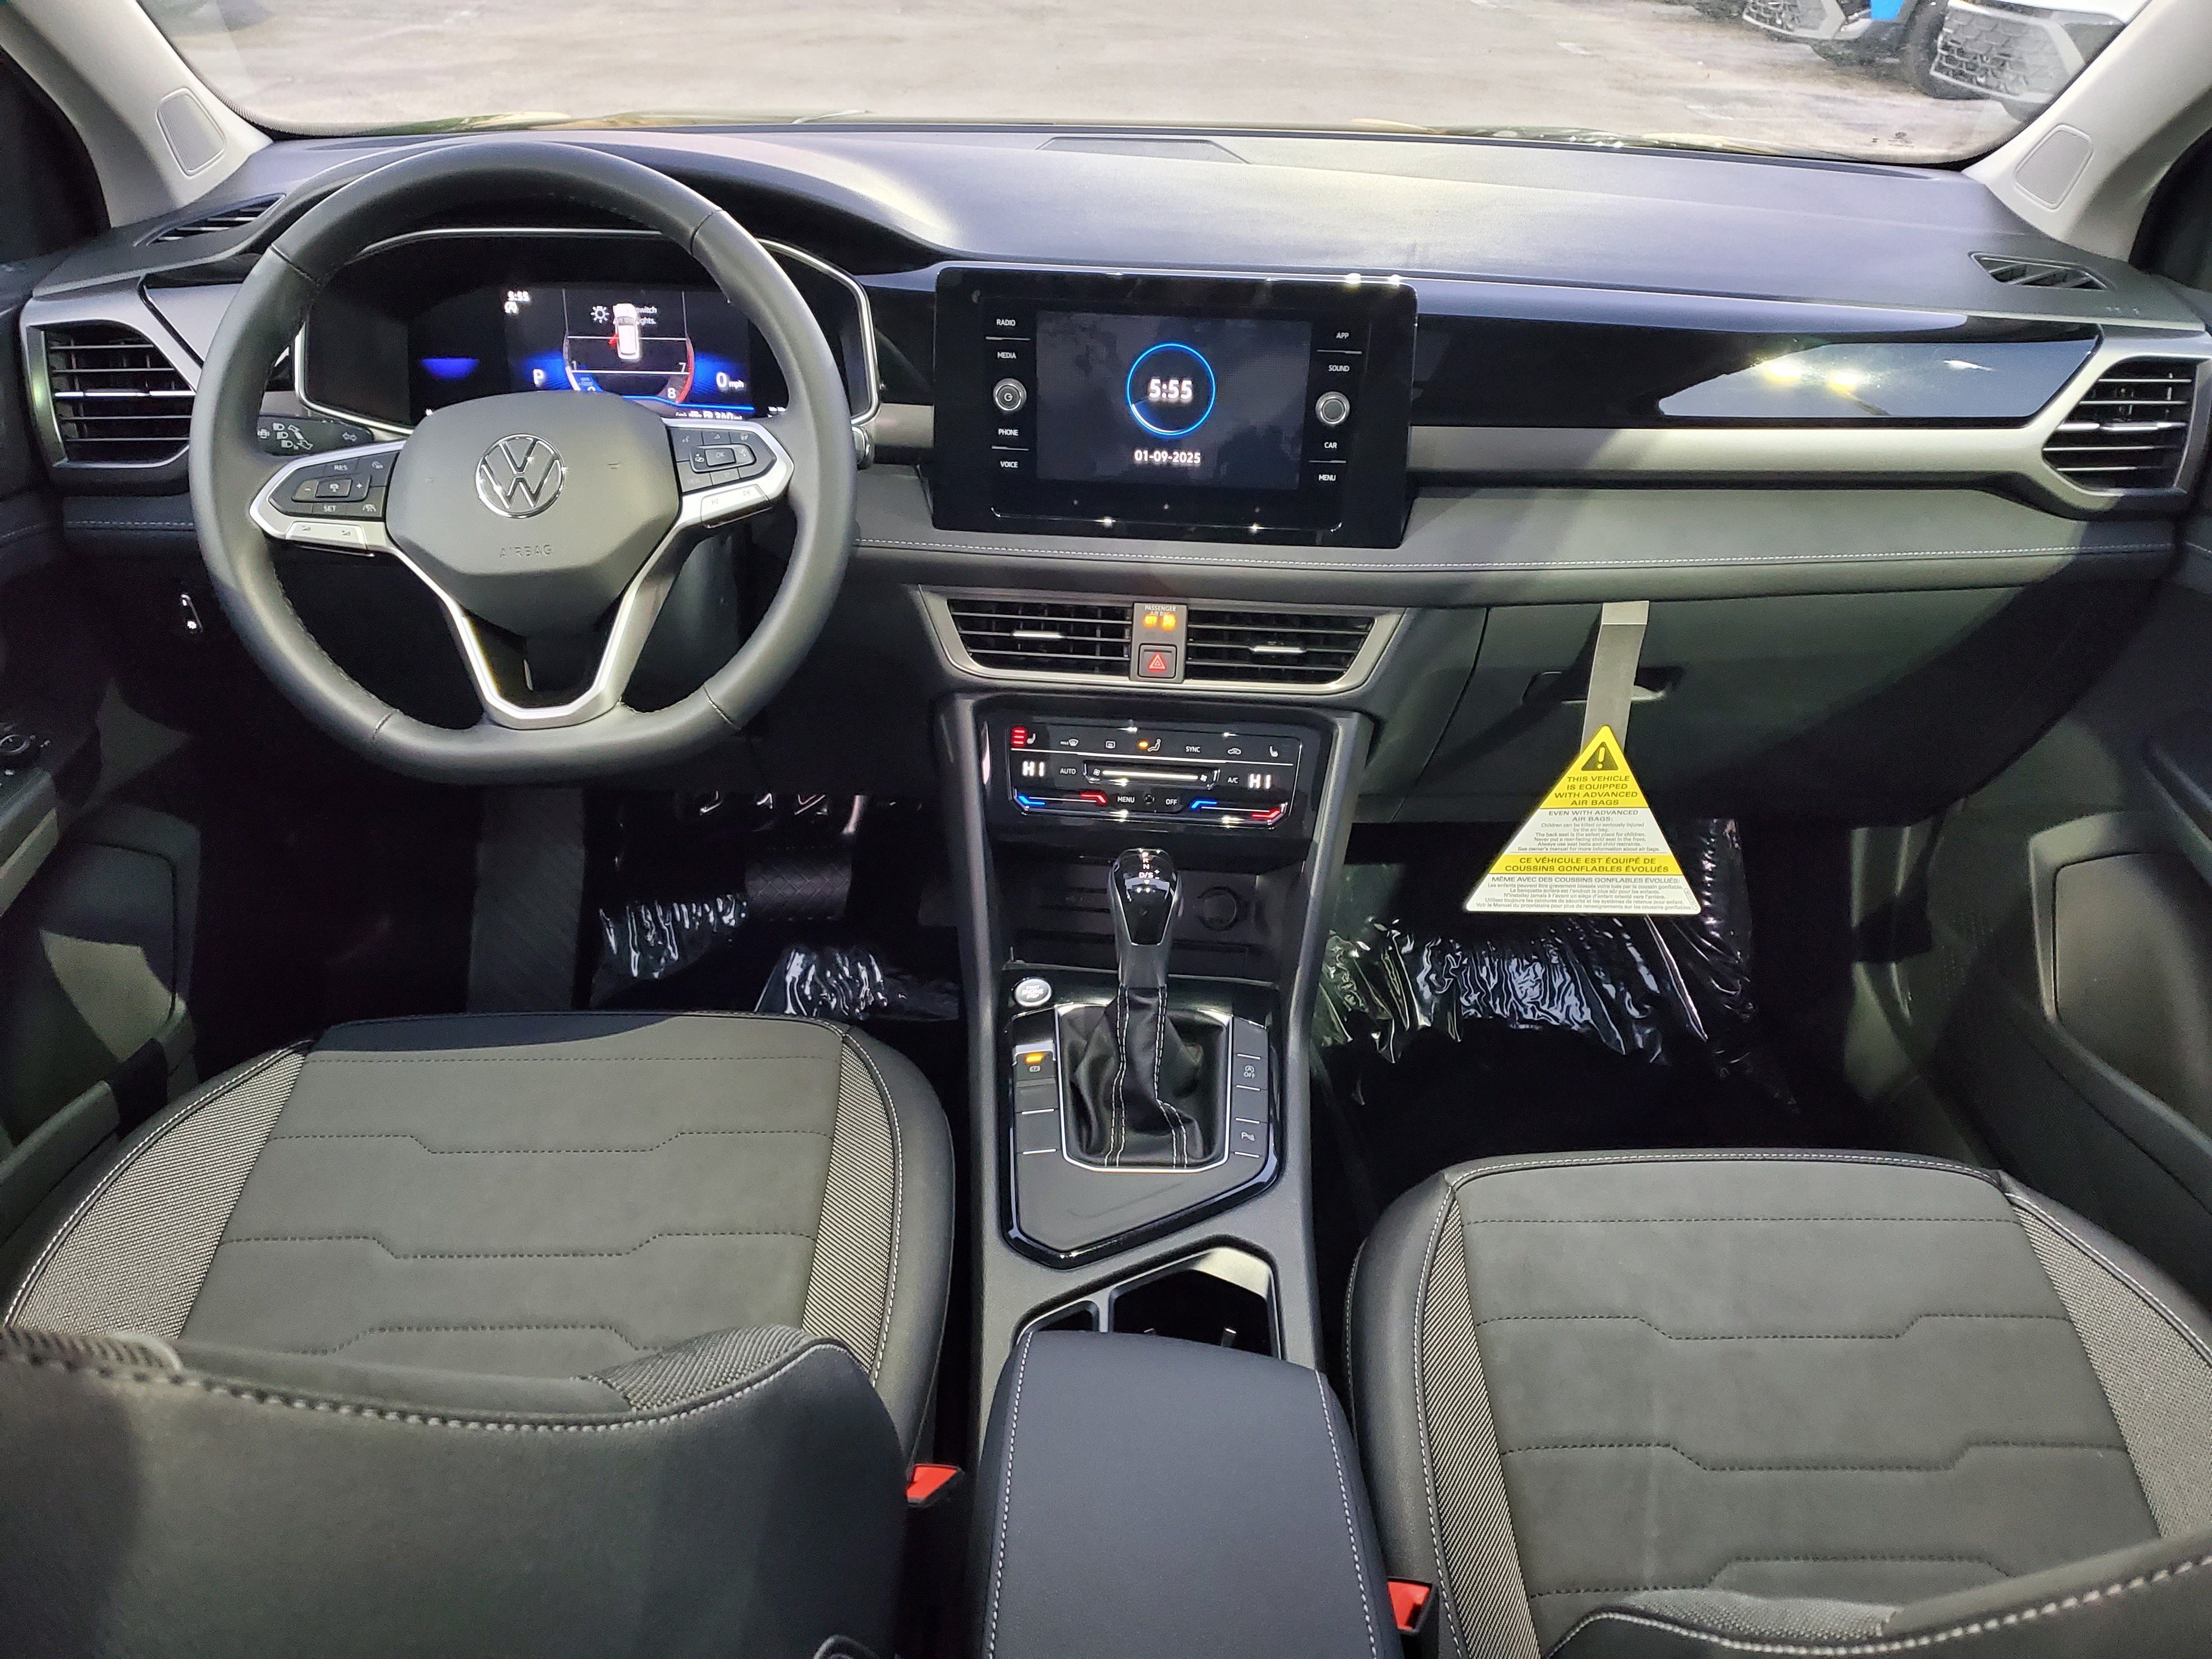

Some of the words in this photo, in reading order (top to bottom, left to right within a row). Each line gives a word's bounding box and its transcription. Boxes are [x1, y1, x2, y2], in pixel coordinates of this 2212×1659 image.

[997, 351, 1017, 359] MEDIA
[533, 369, 544, 386] P
[728, 380, 745, 390] mph
[1149, 378, 1193, 399] 5:55
[667, 387, 676, 399] 8
[1134, 449, 1201, 464] 01-09-2025
[1023, 760, 1045, 777] HI
[1249, 774, 1272, 789] HI
[1605, 856, 1640, 865] ÉQUIPÉ
[1625, 865, 1669, 873] ÉVOLUÉS
